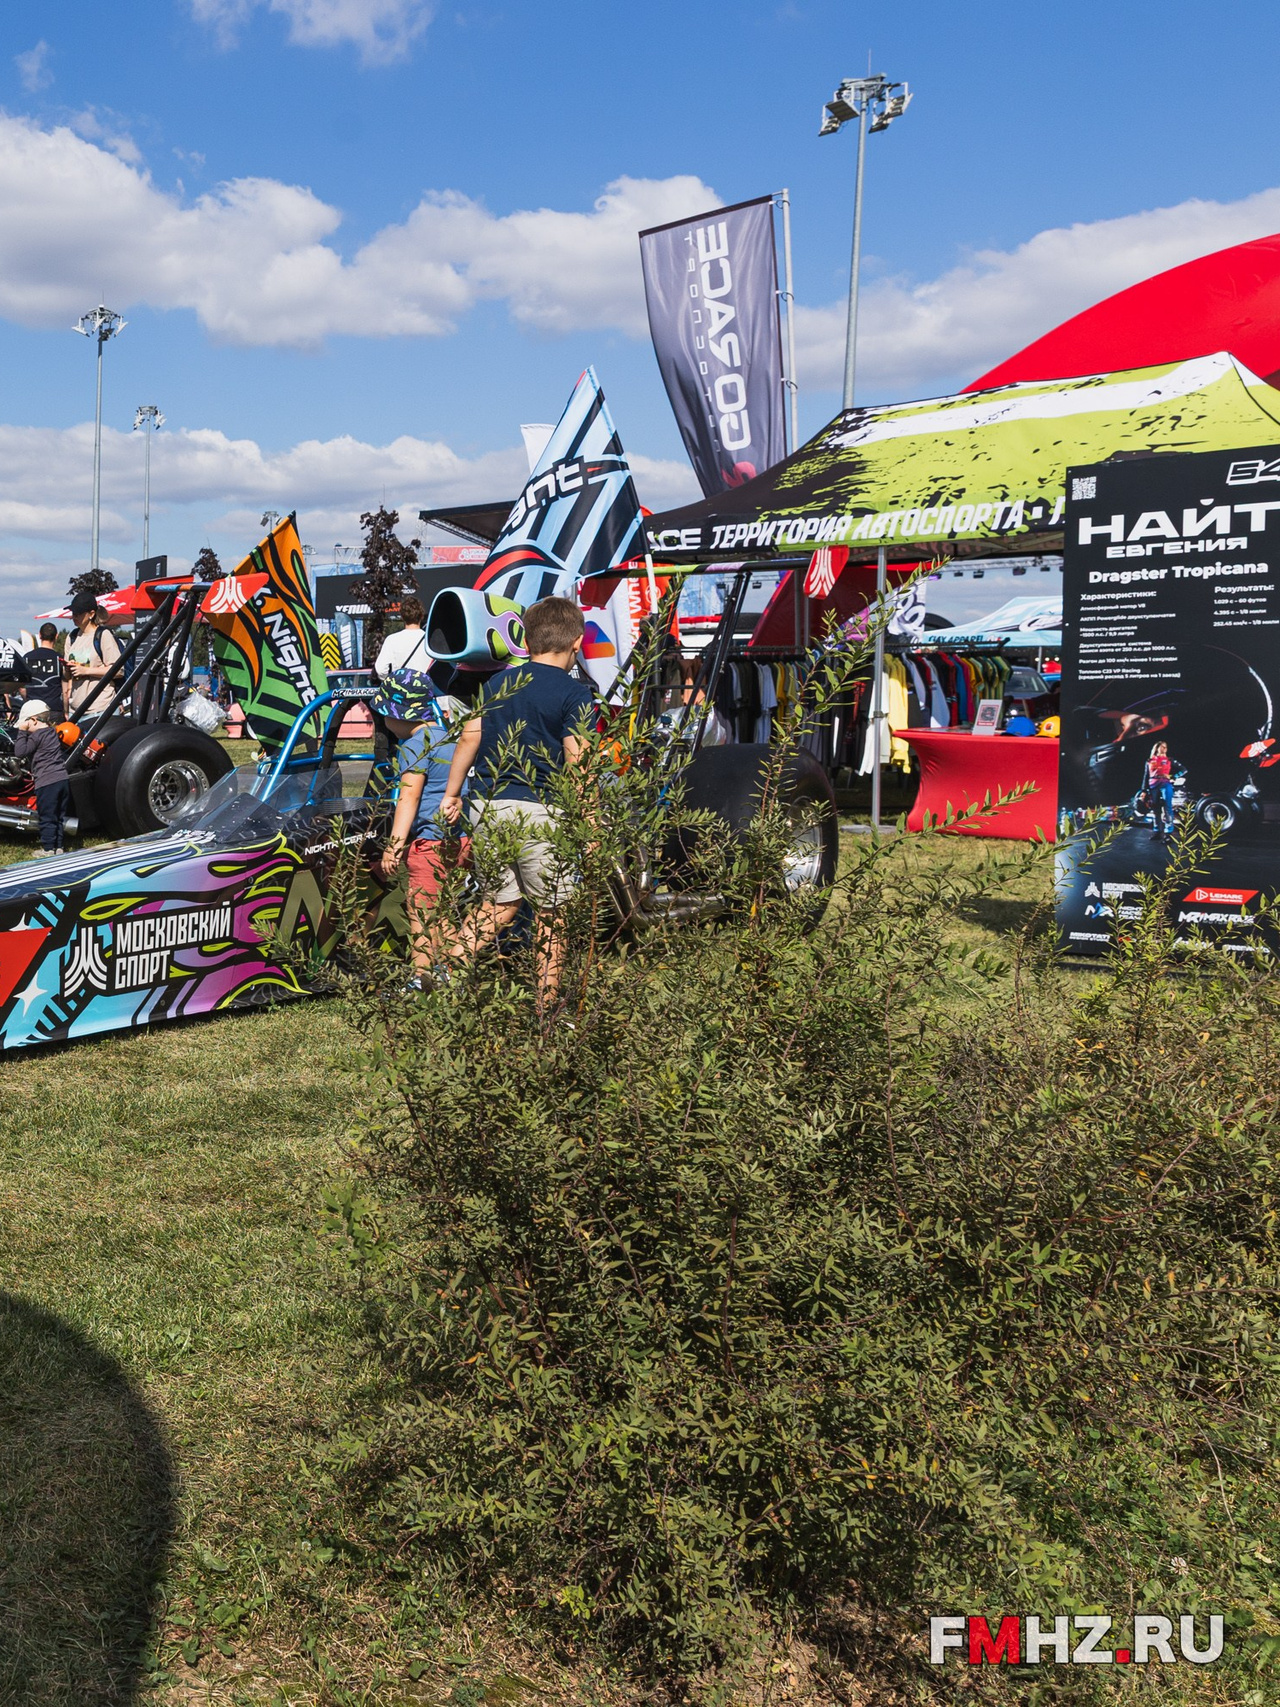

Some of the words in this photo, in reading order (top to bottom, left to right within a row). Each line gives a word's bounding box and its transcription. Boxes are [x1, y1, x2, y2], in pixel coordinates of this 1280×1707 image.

[710, 515, 850, 549] ТЕРРИТОРИЯ
[851, 500, 1023, 541] АВТОСПОРТА
[1078, 498, 1280, 545] НАЙТ
[1106, 536, 1248, 559] ЕВГЕНИЯ
[1089, 567, 1168, 585] Dragster
[1172, 561, 1269, 580] Tropicana
[1080, 591, 1157, 601] Характеристики:
[1214, 584, 1275, 594] Результаты:
[1209, 892, 1243, 900] LEMARC
[116, 901, 231, 954] МОСКОВСКИЙ
[115, 949, 171, 989] СПОРТ
